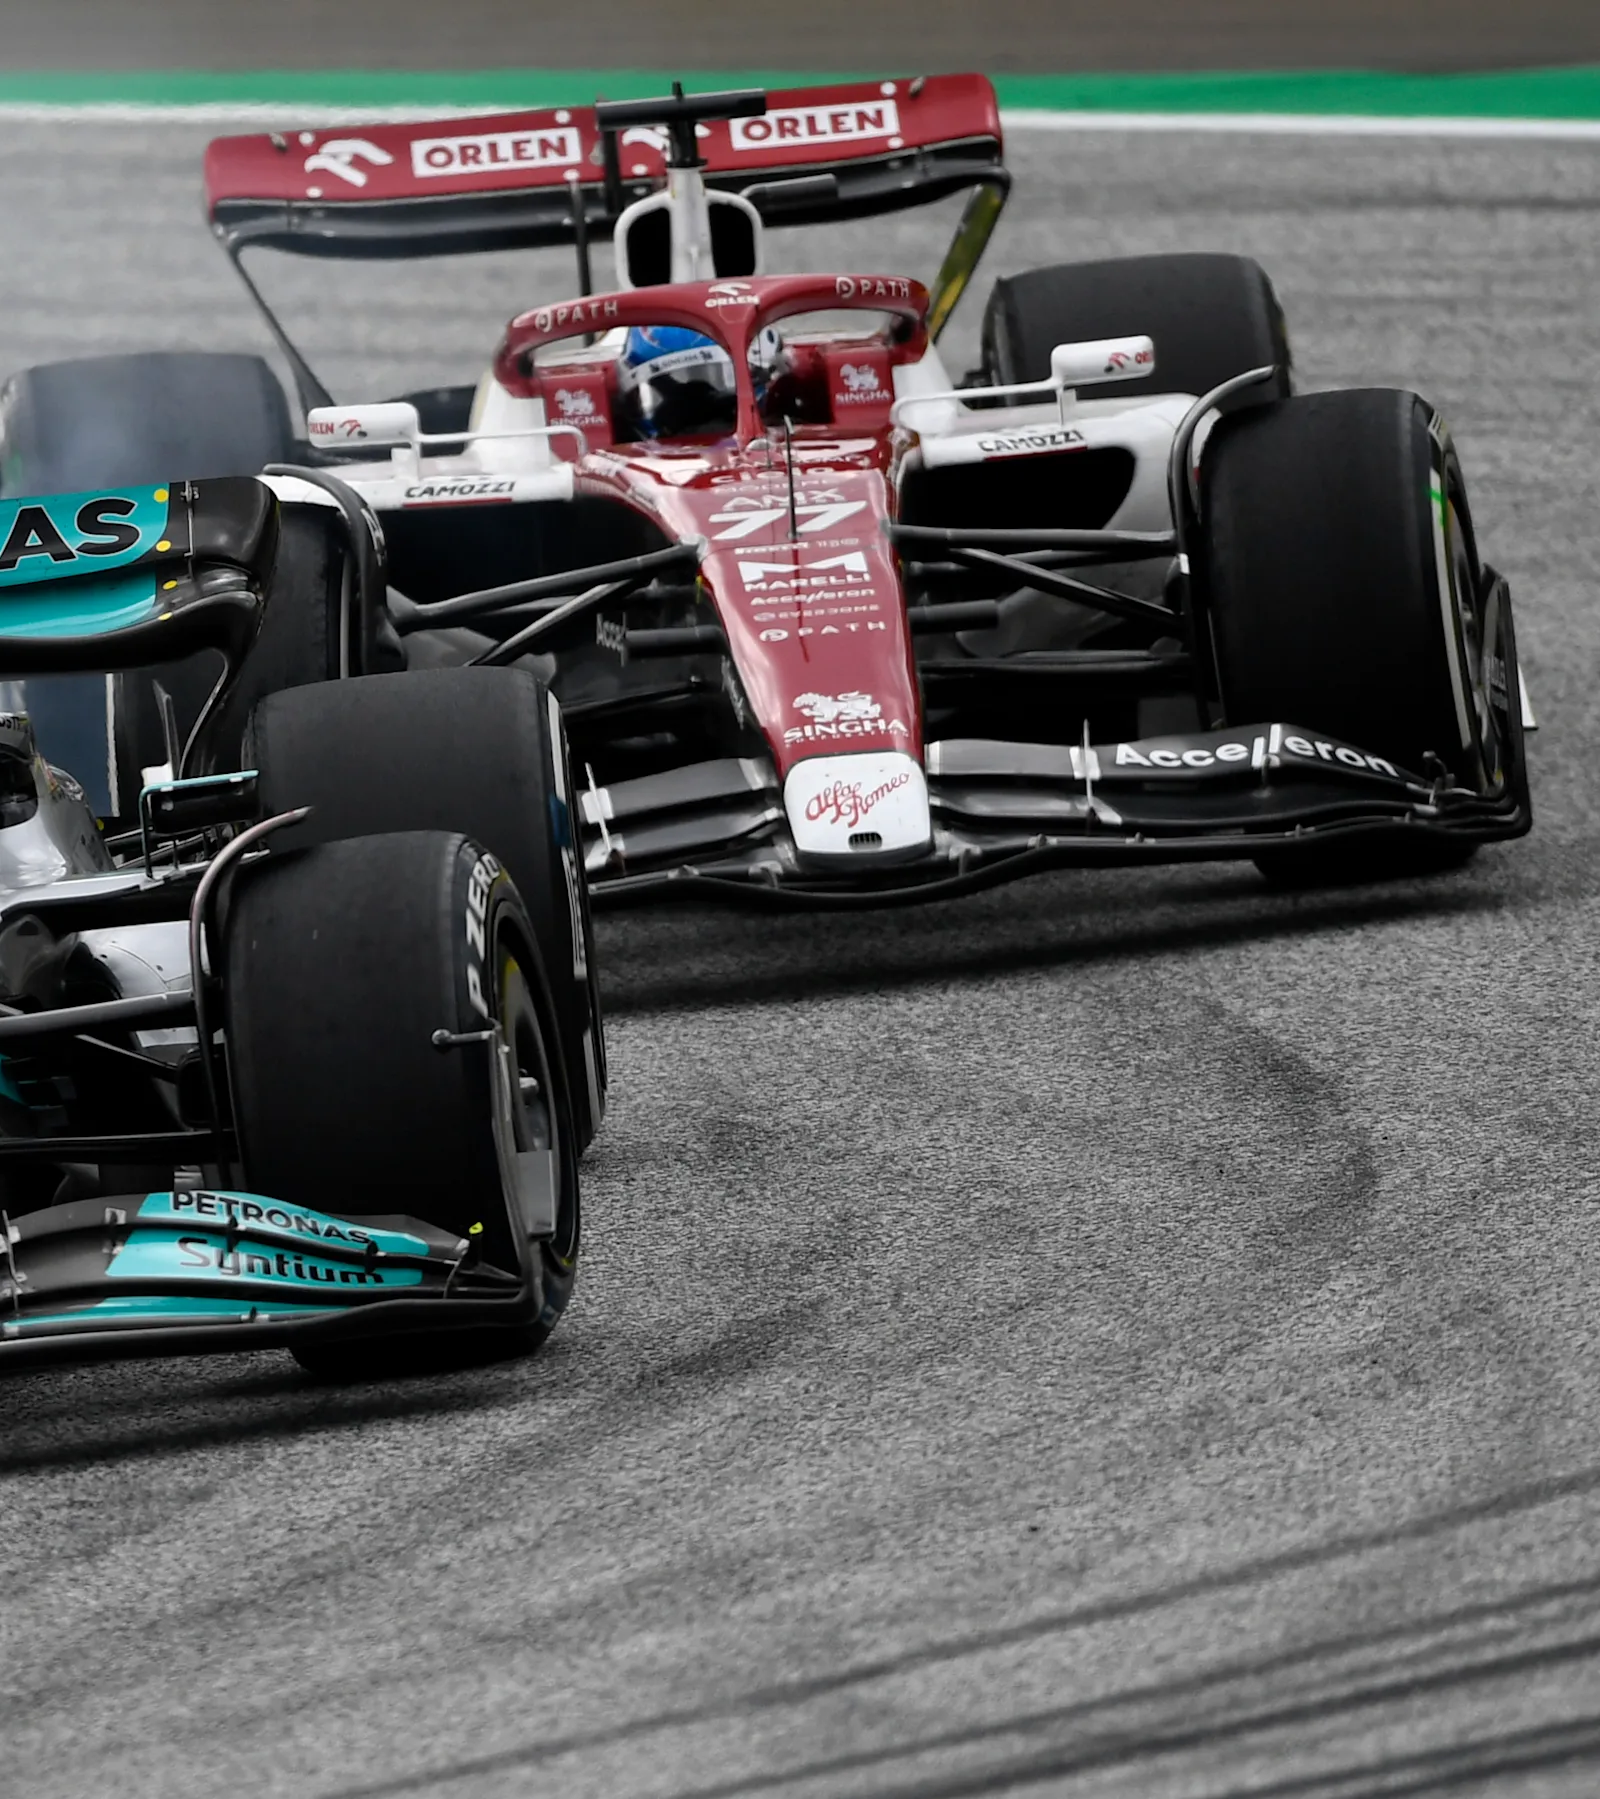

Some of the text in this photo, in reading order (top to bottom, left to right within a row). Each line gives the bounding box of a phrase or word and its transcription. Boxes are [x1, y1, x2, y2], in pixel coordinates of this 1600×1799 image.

[741, 107, 885, 142] ORLEN
[424, 135, 568, 169] ORLEN
[704, 293, 760, 308] ORLEN
[860, 279, 910, 298] PATH
[556, 299, 619, 327] PATH
[835, 390, 891, 404] SINGHA
[550, 412, 608, 427] SINGHA
[977, 429, 1086, 452] CAMOZZI
[404, 480, 516, 499] CAMOZZI
[707, 500, 868, 541] 77
[743, 572, 872, 593] MARELLI
[797, 620, 887, 637] PATH
[782, 718, 908, 744] SINGHA
[1115, 722, 1400, 778] Accelleron
[838, 772, 910, 828] Romeo
[170, 1190, 370, 1245] PETRONAS
[176, 1235, 385, 1285] Syntium
